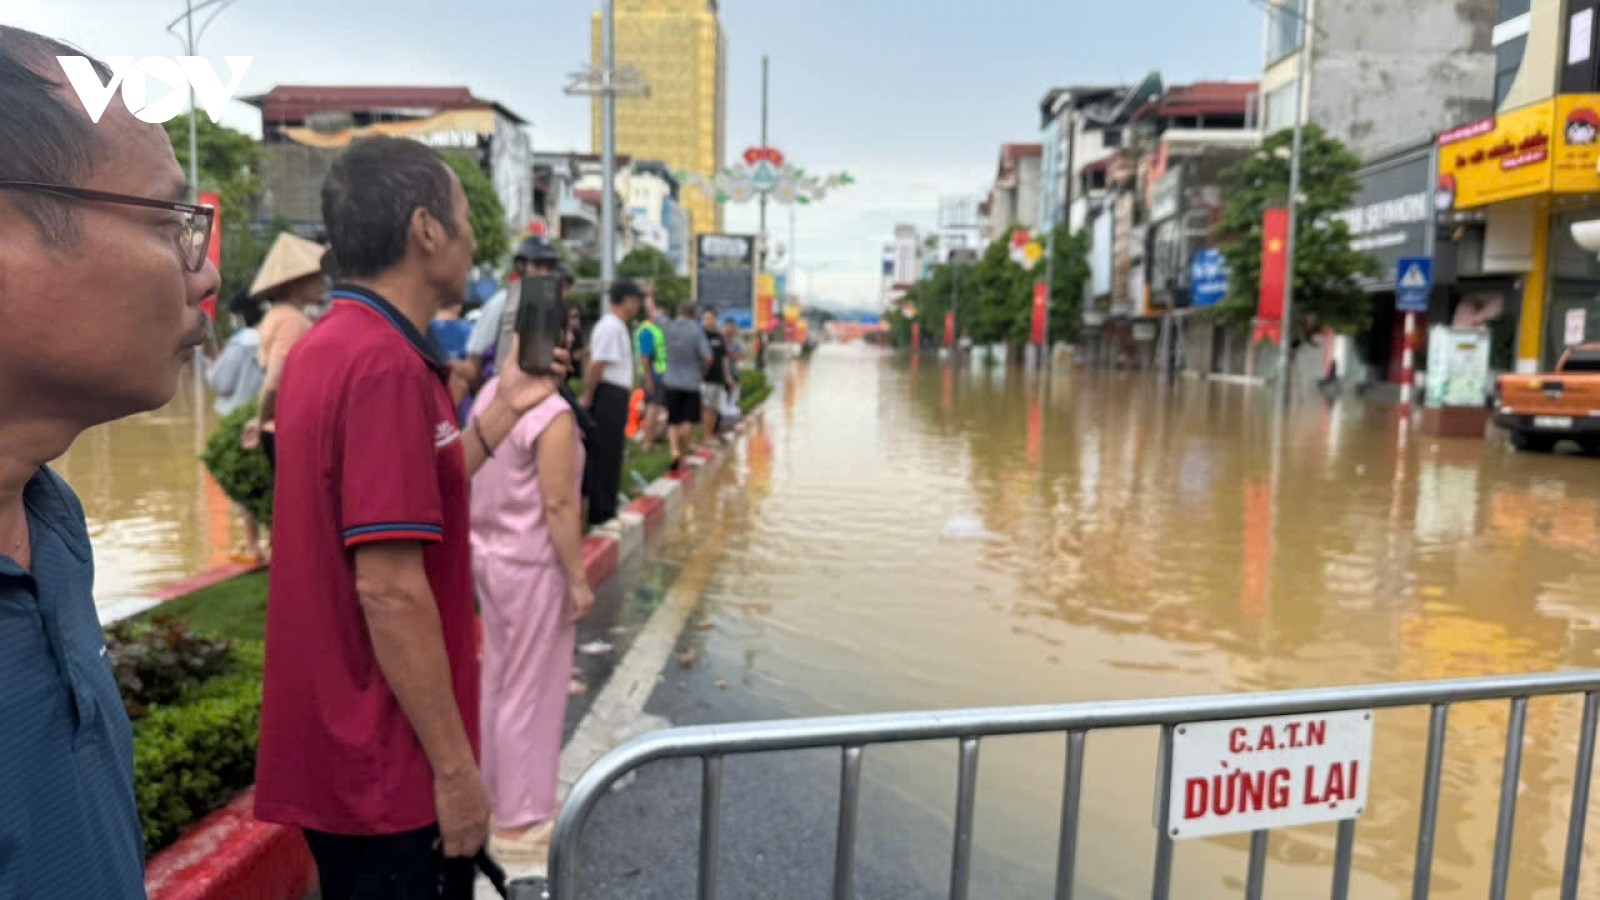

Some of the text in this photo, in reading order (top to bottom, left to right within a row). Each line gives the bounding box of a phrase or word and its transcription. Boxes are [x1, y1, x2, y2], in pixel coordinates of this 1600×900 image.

[1229, 719, 1326, 754] C.A.T.N
[1184, 759, 1359, 820] DỪNG LẠI
